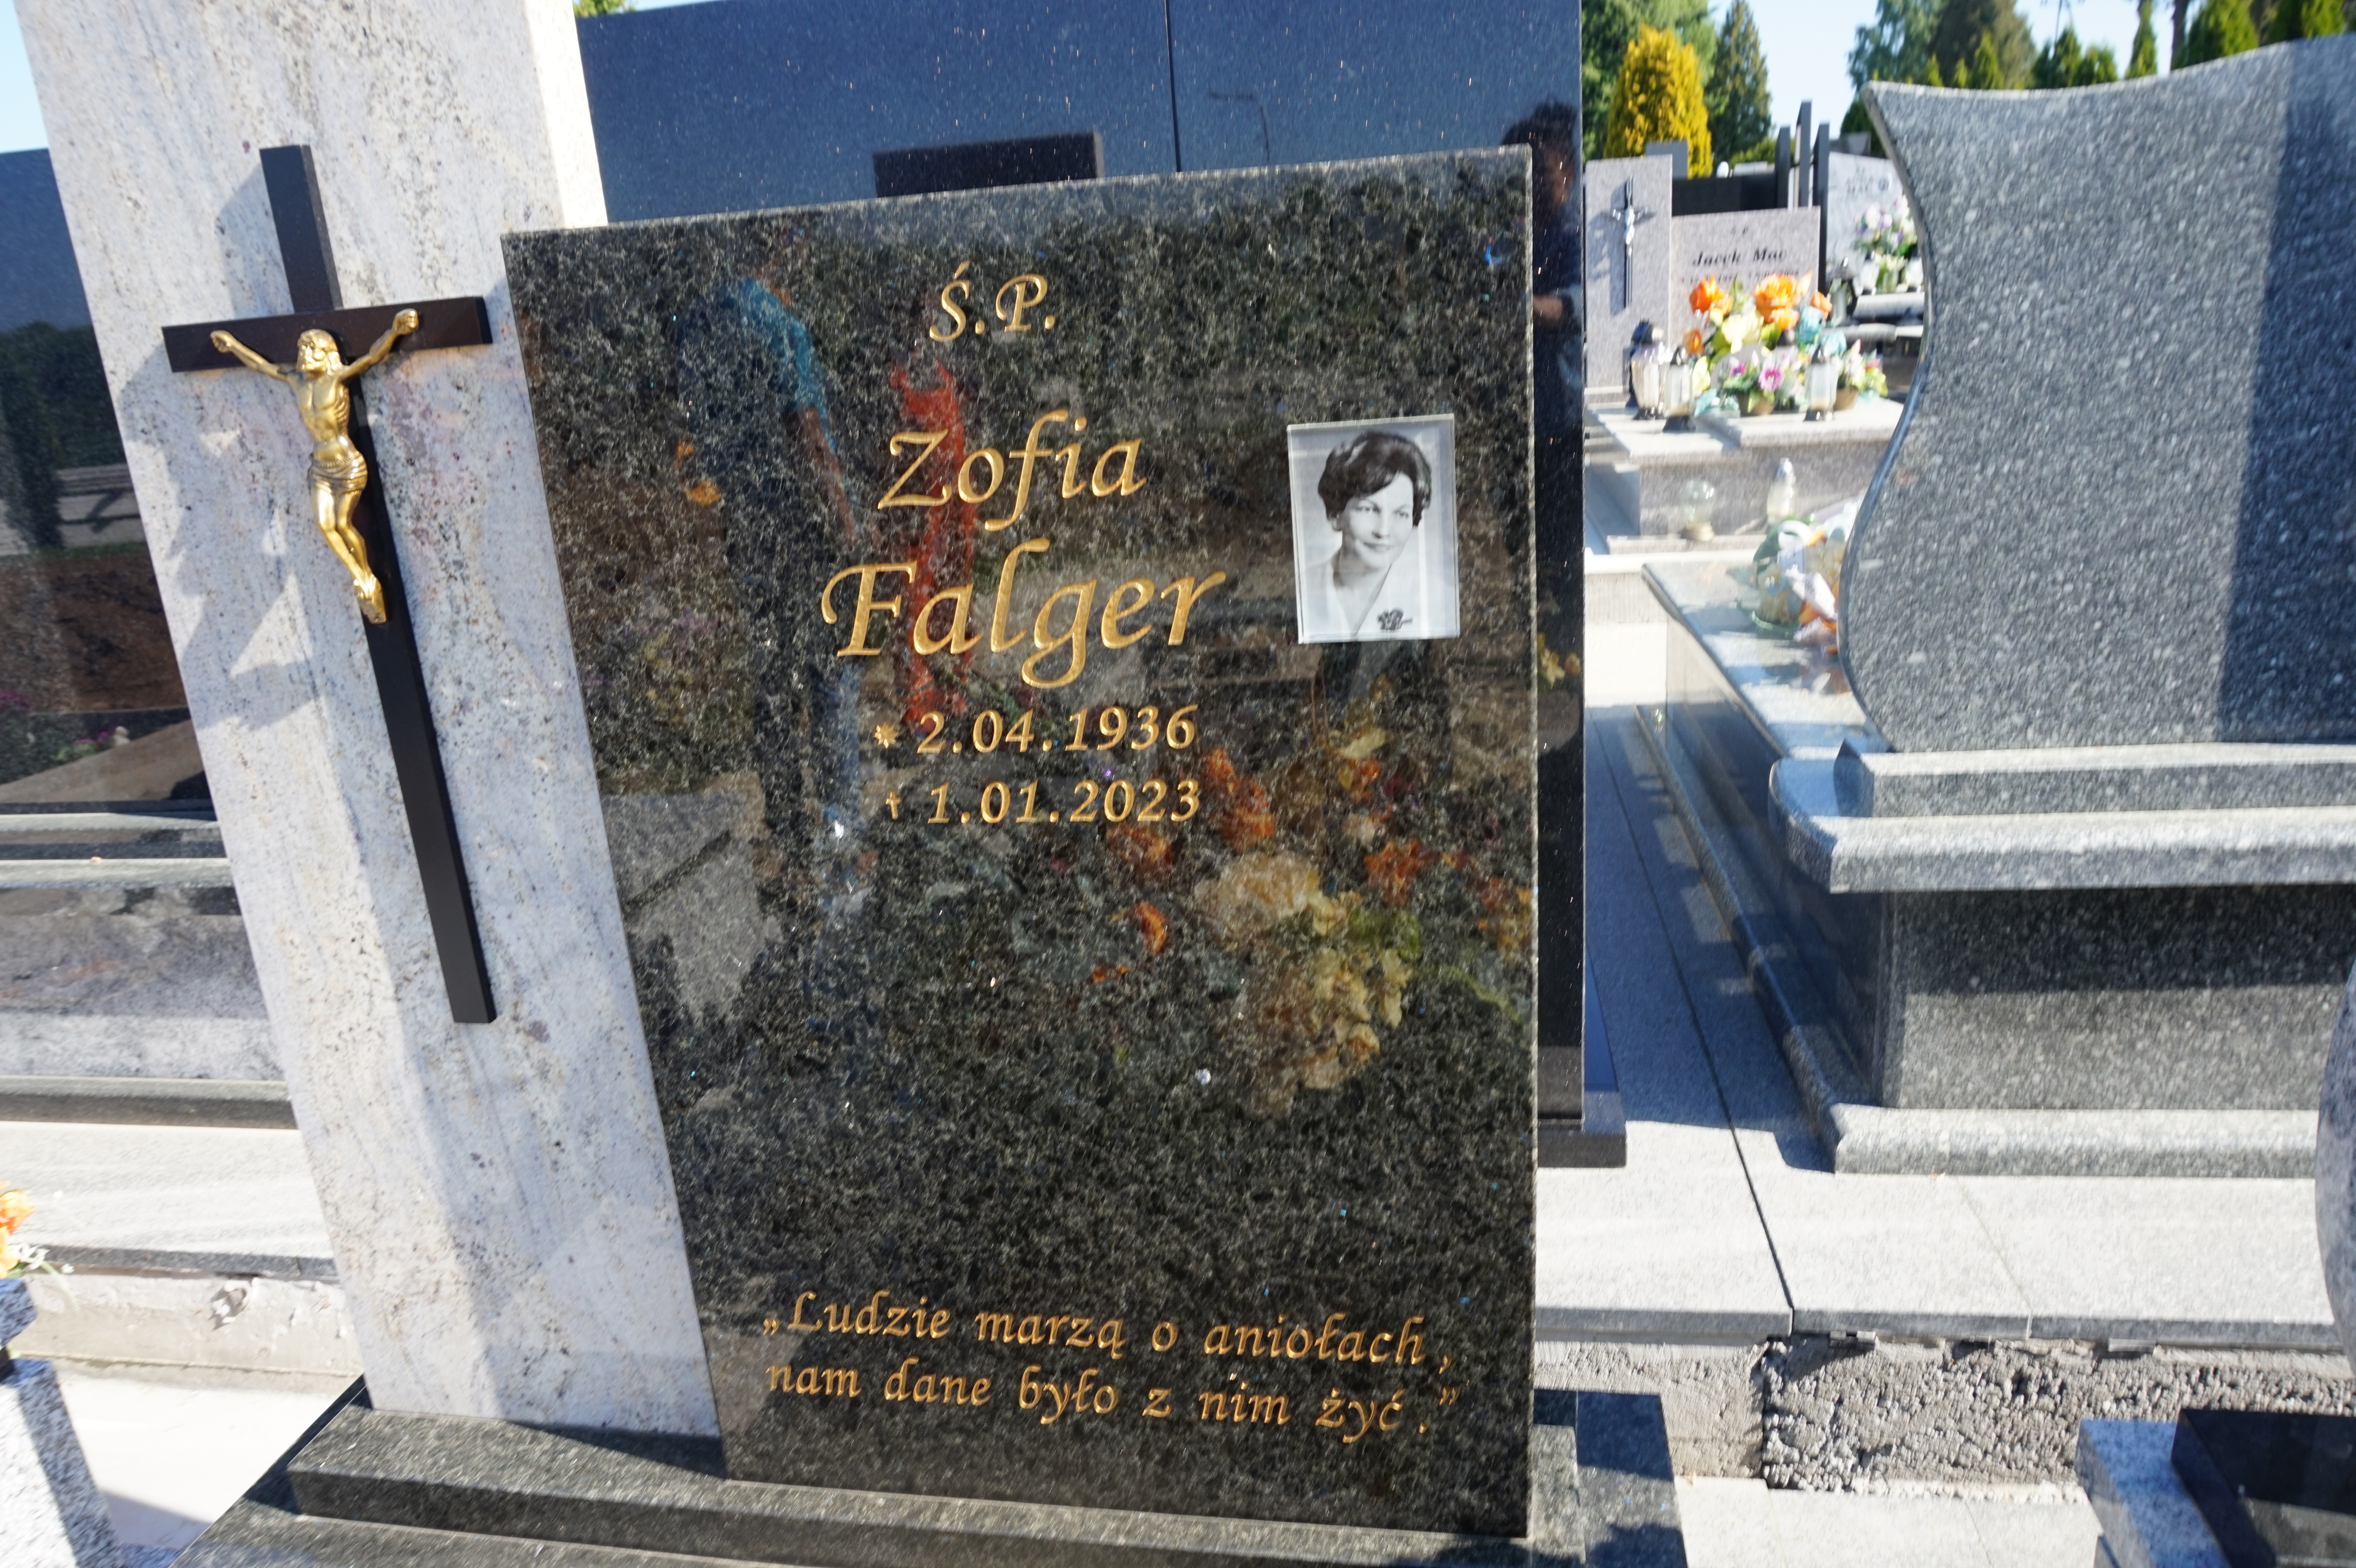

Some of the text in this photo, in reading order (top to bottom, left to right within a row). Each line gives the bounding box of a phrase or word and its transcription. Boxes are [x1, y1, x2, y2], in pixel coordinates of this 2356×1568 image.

[929, 262, 1056, 341] Ś.P.
[877, 409, 1147, 531] Zofia
[821, 537, 1227, 689] Falger
[916, 704, 1199, 754] 2.04.1936
[928, 771, 1200, 824] 1.01.2023
[763, 1290, 1452, 1375] „Ludzie marzą o aniołach,
[765, 1364, 862, 1398] nam
[884, 1356, 991, 1406] dane
[1019, 1365, 1118, 1425] było
[1142, 1388, 1172, 1418] z
[1198, 1381, 1291, 1426] nim
